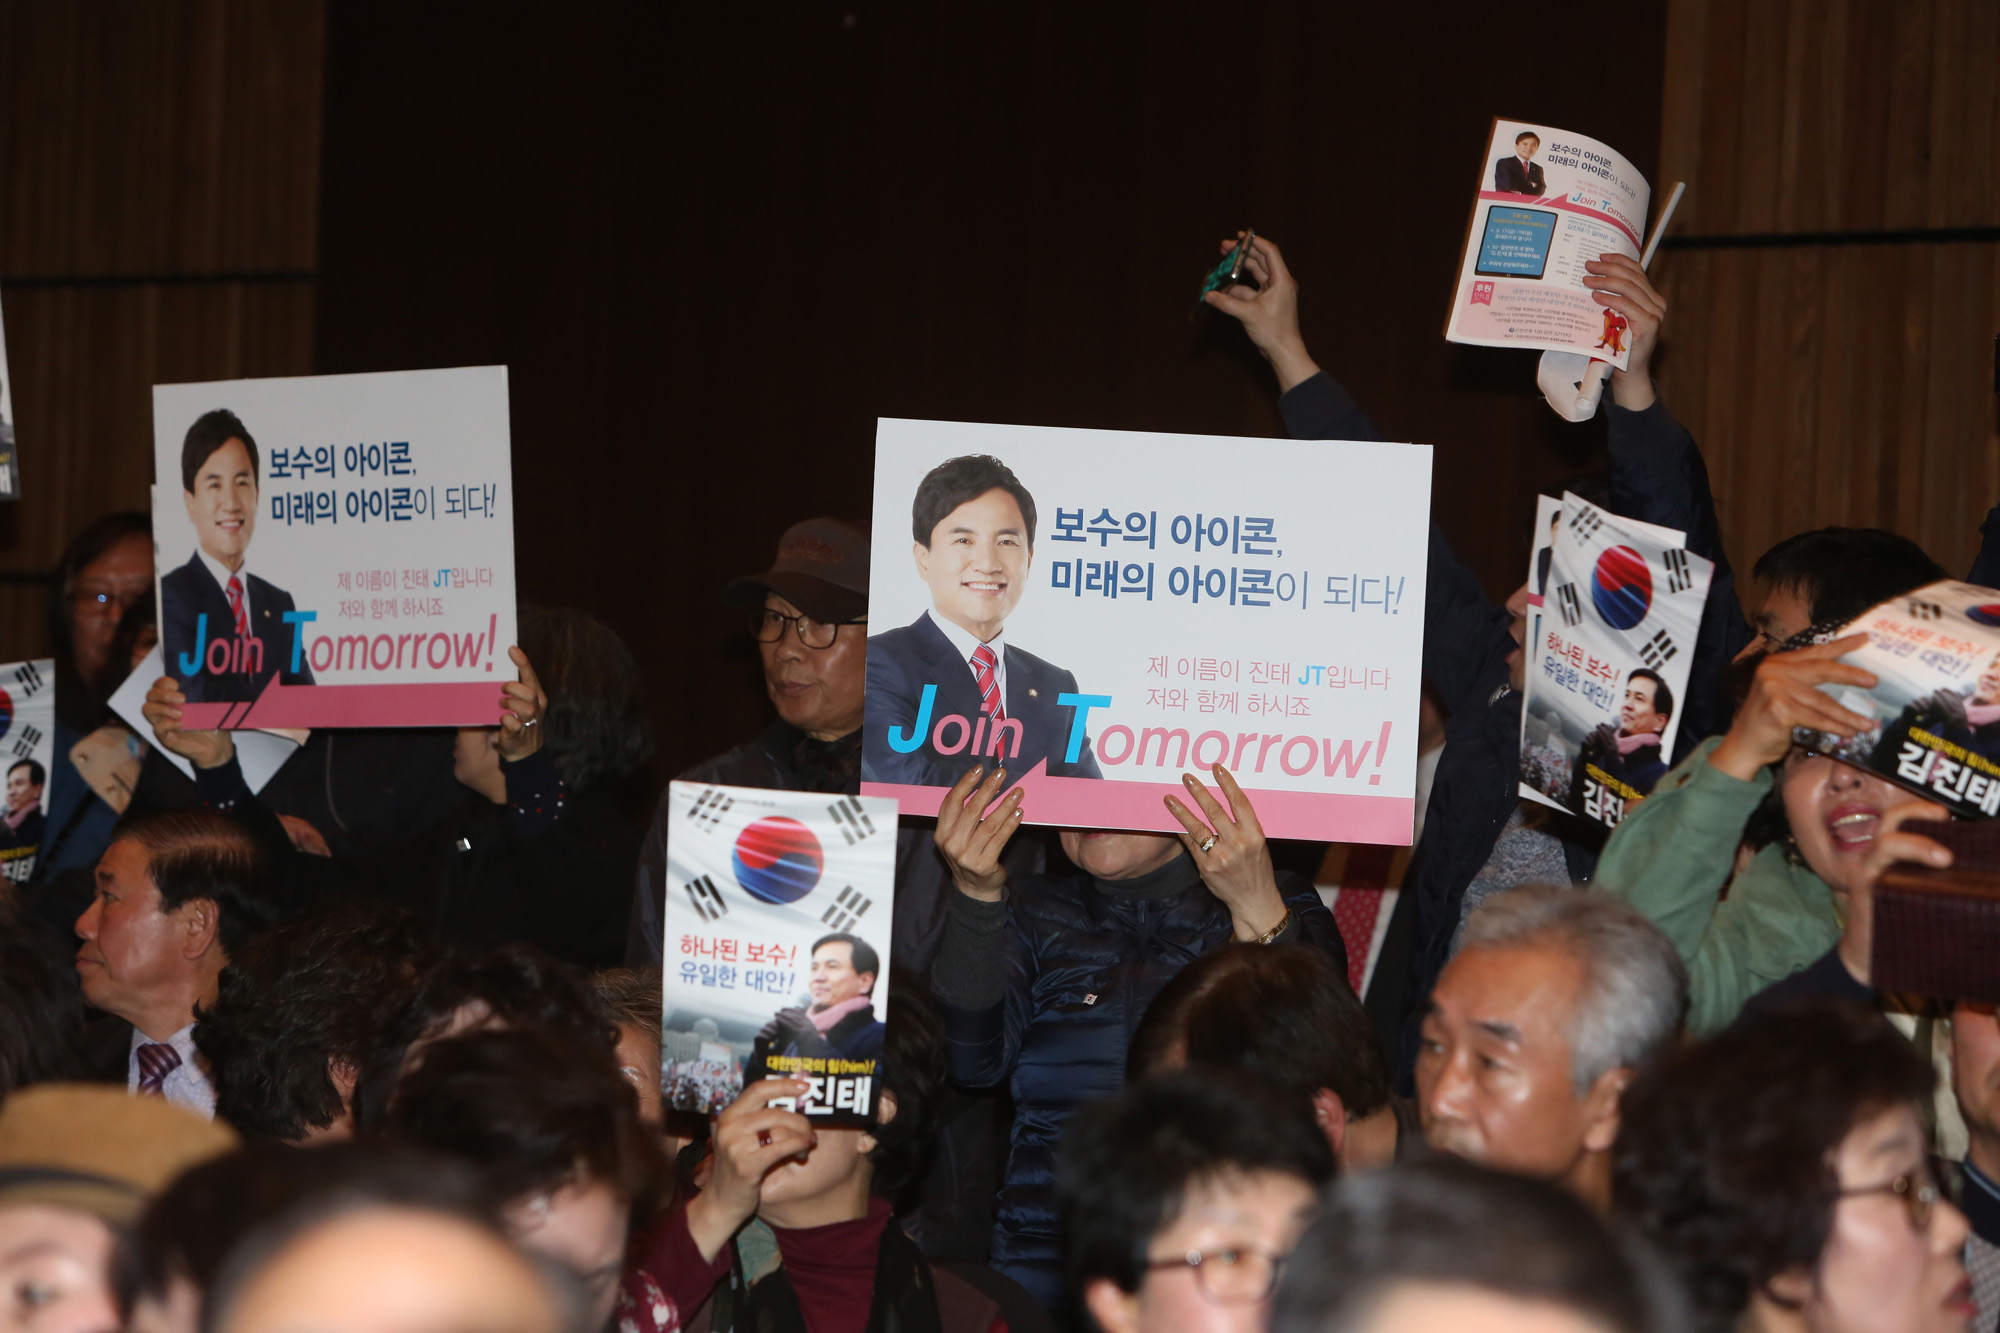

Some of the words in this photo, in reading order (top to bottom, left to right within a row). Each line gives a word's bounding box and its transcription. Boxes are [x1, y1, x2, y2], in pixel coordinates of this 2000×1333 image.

[1550, 143, 1581, 157] 보수의
[1548, 155, 1579, 169] 미래의
[1581, 162, 1618, 184] 아이콘이
[1620, 180, 1636, 199] 되다!
[1572, 192, 1597, 207] Join
[1601, 200, 1641, 239] Tomorrow!
[1474, 292, 1490, 301] 안내
[1475, 284, 1492, 293] 후원
[269, 444, 336, 480] 보수의
[344, 441, 416, 477] 아이콘,
[271, 489, 337, 526] 미래의
[346, 485, 435, 523] 아이콘이
[445, 483, 496, 519] 되다!
[1050, 507, 1157, 549] 보수의
[1170, 513, 1283, 558] 아이콘,
[337, 571, 351, 592] 제
[355, 569, 397, 592] 이름이
[402, 568, 429, 590] 진태
[433, 566, 494, 588] JT입니다
[1051, 558, 1155, 601] 미래의
[1168, 564, 1308, 610] 아이콘이
[1323, 573, 1405, 615] 되다!
[338, 598, 366, 620] 저와
[370, 598, 398, 620] 함께
[402, 597, 445, 618] 하시죠
[179, 613, 264, 677] Join
[282, 610, 497, 675] Tomorrow!
[1873, 619, 1934, 643] 하나된
[1930, 635, 1987, 659] 보수!
[1147, 655, 1169, 679] 제
[1176, 656, 1240, 684] 이름이
[1248, 661, 1291, 686] 진태
[1297, 664, 1392, 691] JT입니다
[1547, 631, 1585, 669] 하나된
[1585, 654, 1621, 688] 보수!
[1919, 649, 1972, 679] 대안!
[1145, 687, 1190, 712] 저와
[1196, 689, 1240, 715] 함께
[1247, 693, 1312, 718] 하시죠
[1543, 656, 1579, 693] 유일한
[1582, 680, 1616, 713] 대안!
[887, 683, 1024, 759] Join
[1056, 692, 1393, 786] Tomorrow!
[1897, 741, 2000, 818] 김진태
[1582, 778, 1629, 829] 김진
[1, 855, 37, 886] 진태
[680, 934, 739, 962] 하나된
[745, 942, 797, 967] 보수!
[679, 960, 738, 989] 유일한
[745, 969, 796, 995] 대안!
[766, 1055, 826, 1073] 대한민국의
[827, 1058, 877, 1075] 힘(him)!
